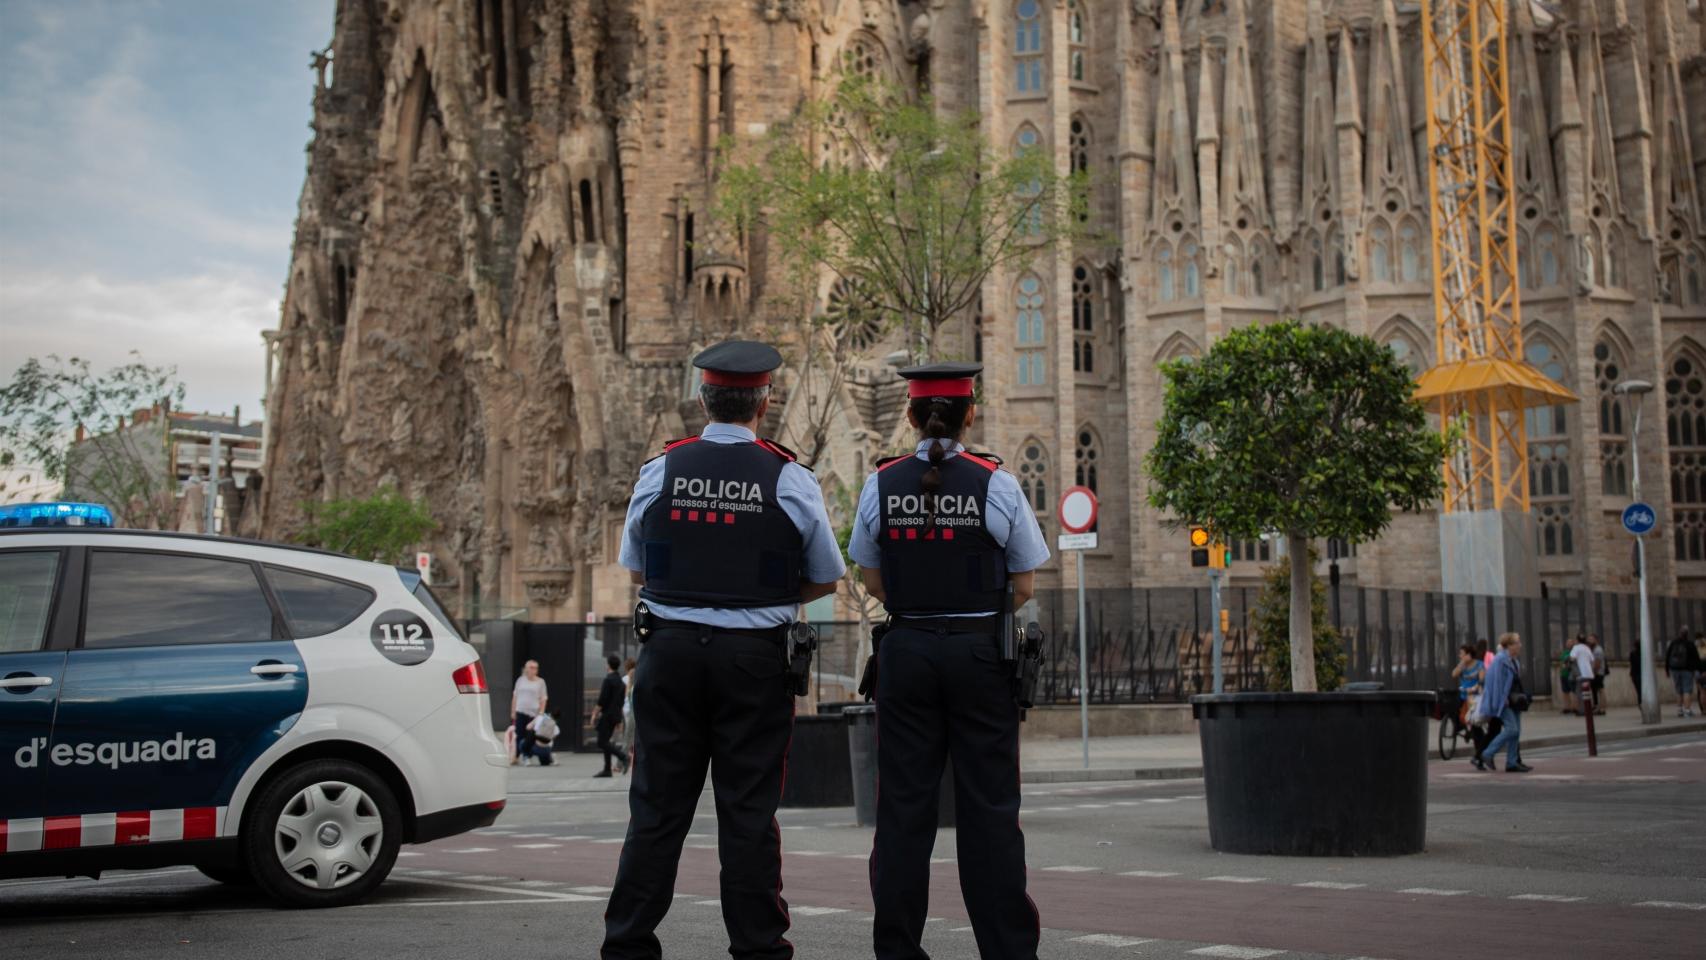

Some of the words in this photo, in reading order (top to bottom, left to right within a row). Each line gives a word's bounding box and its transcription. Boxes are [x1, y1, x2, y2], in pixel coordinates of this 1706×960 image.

[673, 477, 763, 502] POLICIA
[672, 499, 708, 508] mossos
[710, 499, 763, 513] d'esquadra
[887, 495, 980, 515] POLICIA
[888, 517, 925, 526] mossos
[927, 515, 980, 527] 'esquadra
[379, 623, 425, 645] 112
[15, 732, 216, 769] d'esquadra
